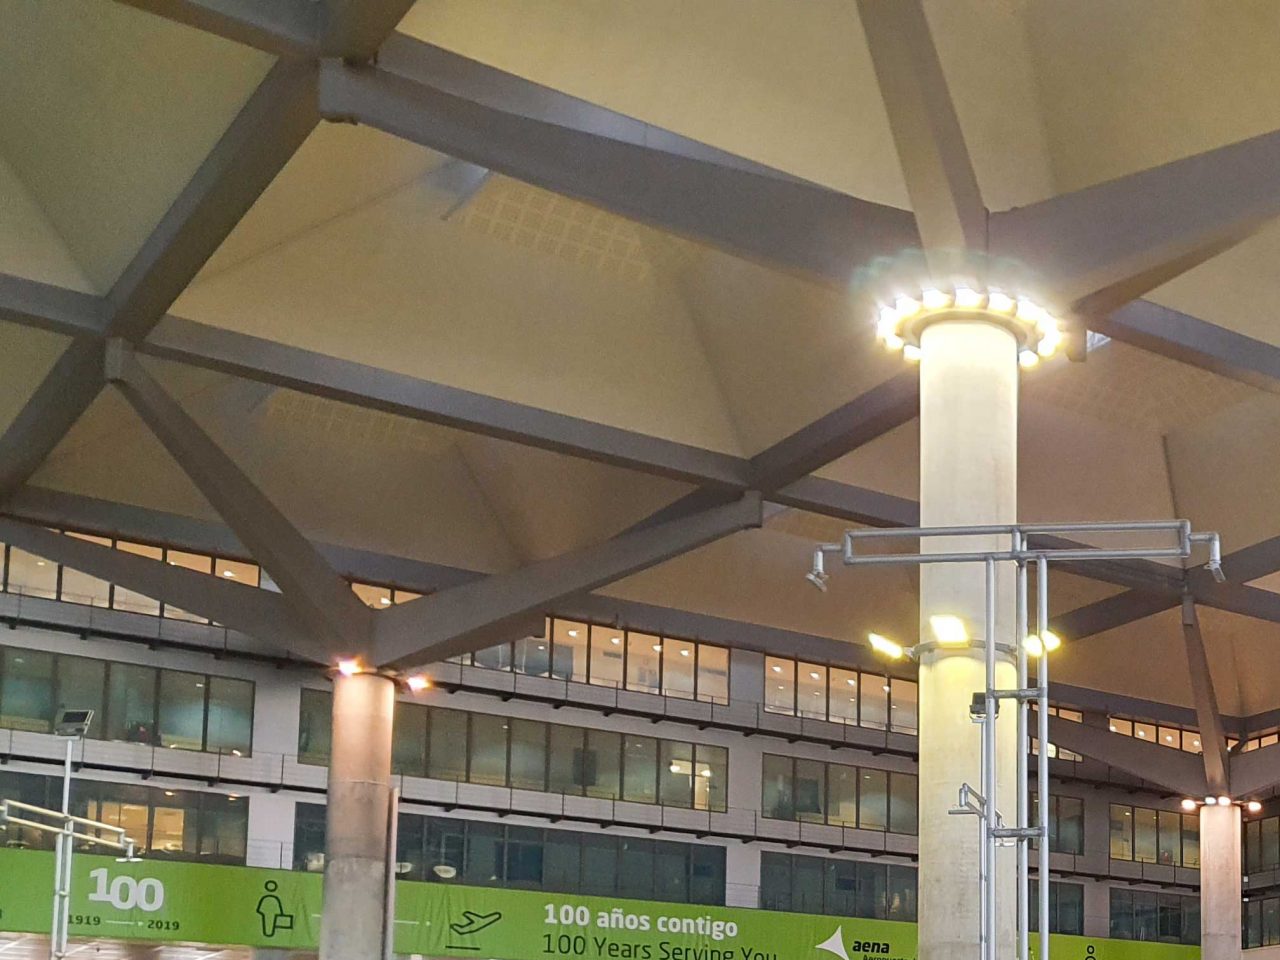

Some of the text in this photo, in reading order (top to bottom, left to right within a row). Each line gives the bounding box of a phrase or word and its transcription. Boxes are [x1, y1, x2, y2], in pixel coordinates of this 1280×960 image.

[89, 868, 164, 911] 100
[148, 920, 179, 930] 2019
[544, 903, 738, 940] 100 años contigo
[543, 934, 586, 955] 100
[594, 937, 651, 960] Years
[853, 941, 890, 953] aena
